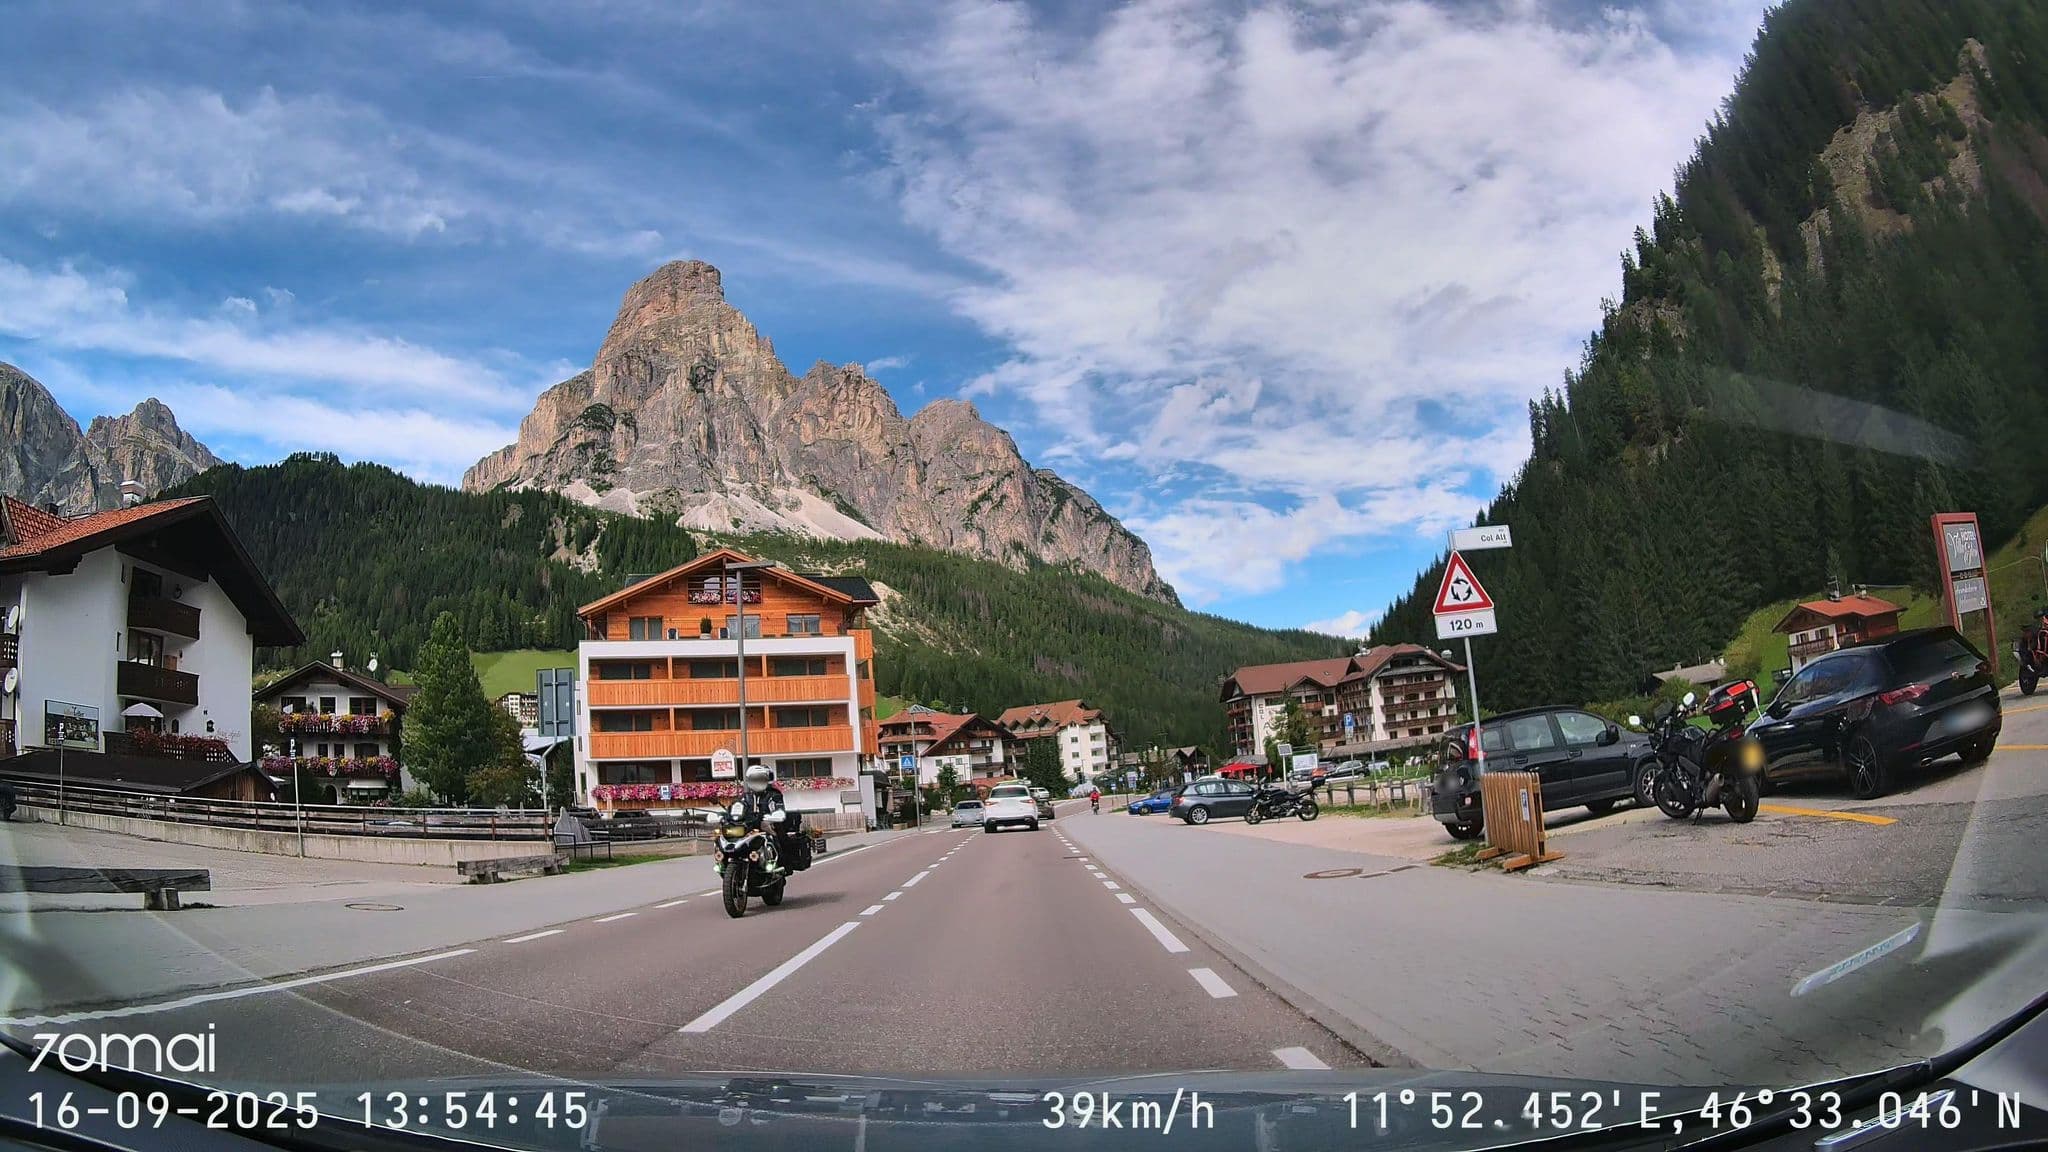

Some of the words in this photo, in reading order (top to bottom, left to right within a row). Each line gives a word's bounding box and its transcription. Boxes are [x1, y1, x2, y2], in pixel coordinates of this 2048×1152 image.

[1480, 534, 1493, 542] Col
[1450, 618, 1472, 631] 120
[1475, 621, 1484, 629] m
